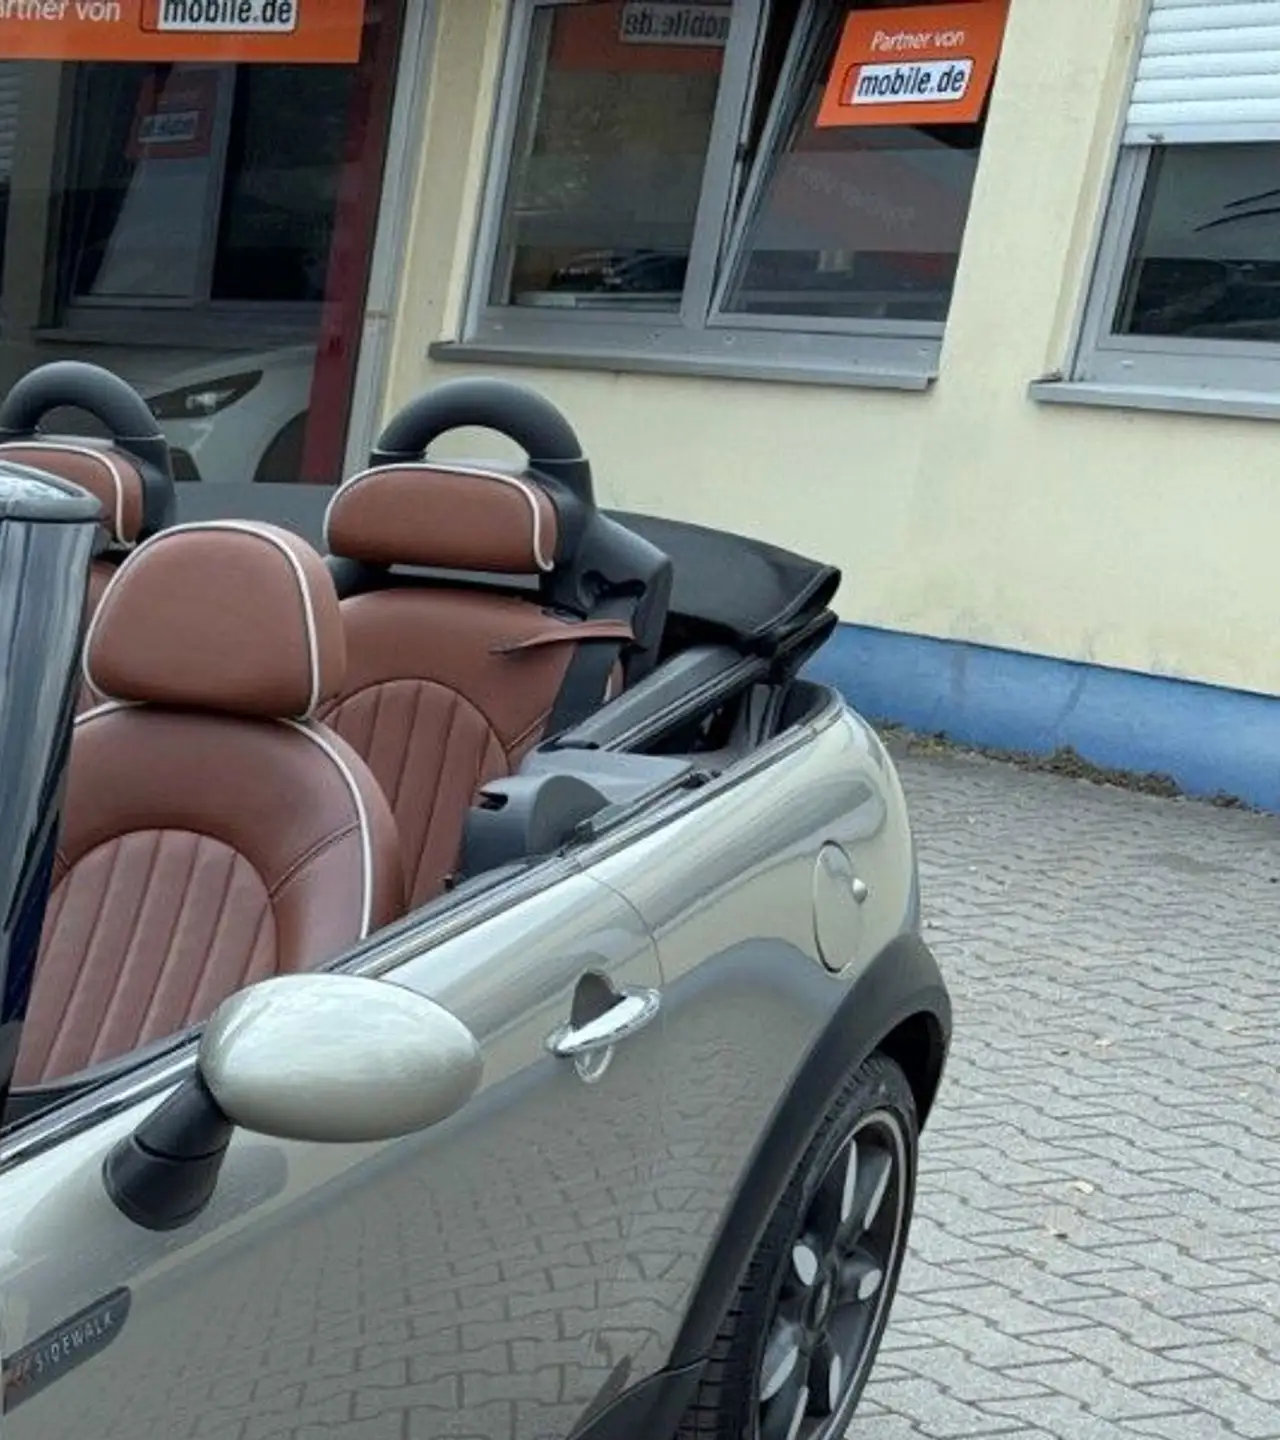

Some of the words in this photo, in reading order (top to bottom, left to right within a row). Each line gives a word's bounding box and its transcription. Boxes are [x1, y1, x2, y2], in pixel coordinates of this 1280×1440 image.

[76, 1, 121, 22] von
[163, 0, 291, 24] mobile.de
[871, 30, 931, 51] Partner
[935, 31, 965, 48] von
[857, 65, 966, 97] mobile.de
[34, 1311, 112, 1373] SIDEWALK
